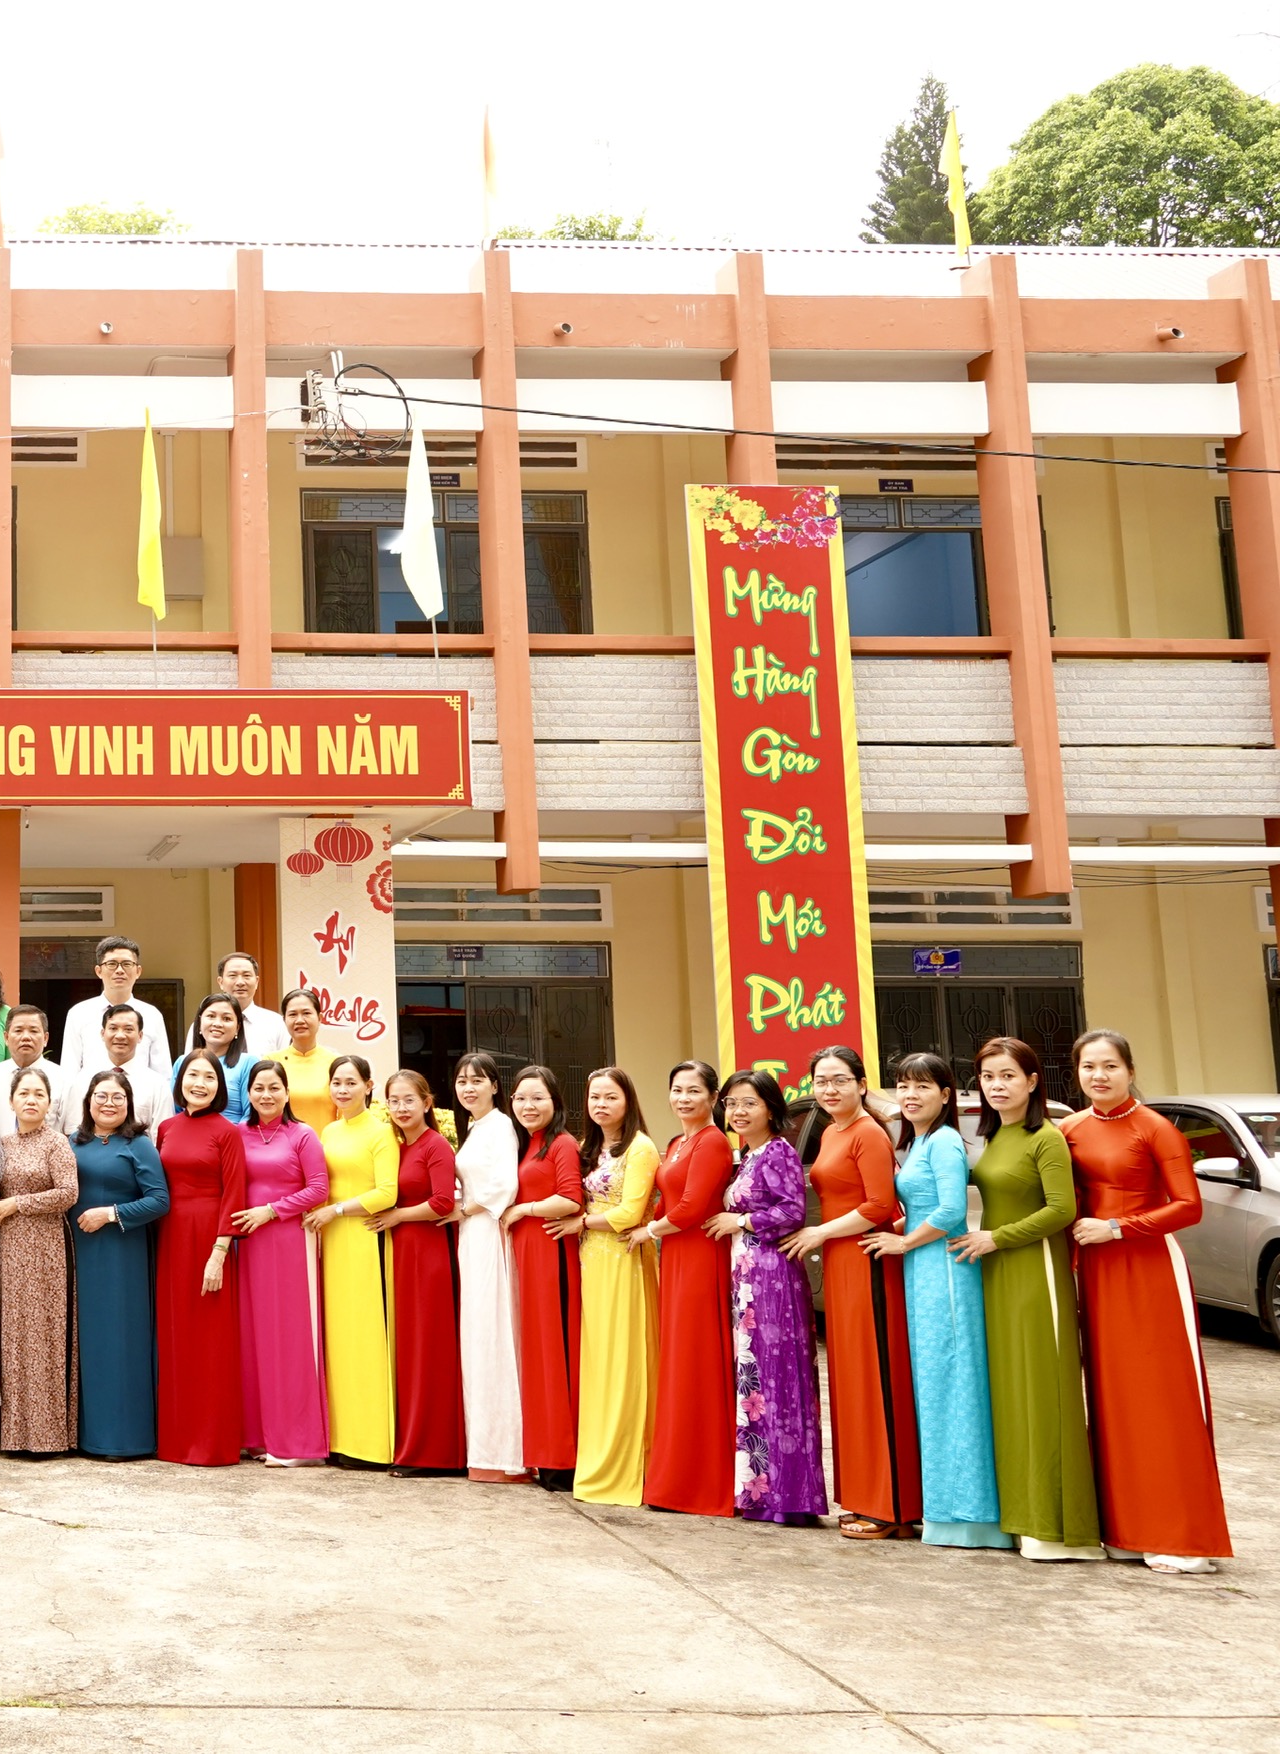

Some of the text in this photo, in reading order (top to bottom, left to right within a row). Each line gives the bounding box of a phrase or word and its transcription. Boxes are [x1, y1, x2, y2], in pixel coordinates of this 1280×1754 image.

[723, 566, 820, 657] Mừng
[731, 645, 821, 738] Hàng
[50, 725, 154, 776] VINH
[170, 714, 302, 776] MUÔN
[318, 713, 419, 776] NĂM
[742, 727, 820, 783] Gòn
[741, 807, 827, 864] Đổi
[313, 911, 356, 975] An
[757, 890, 827, 954] Mới
[744, 973, 847, 1034] Phát
